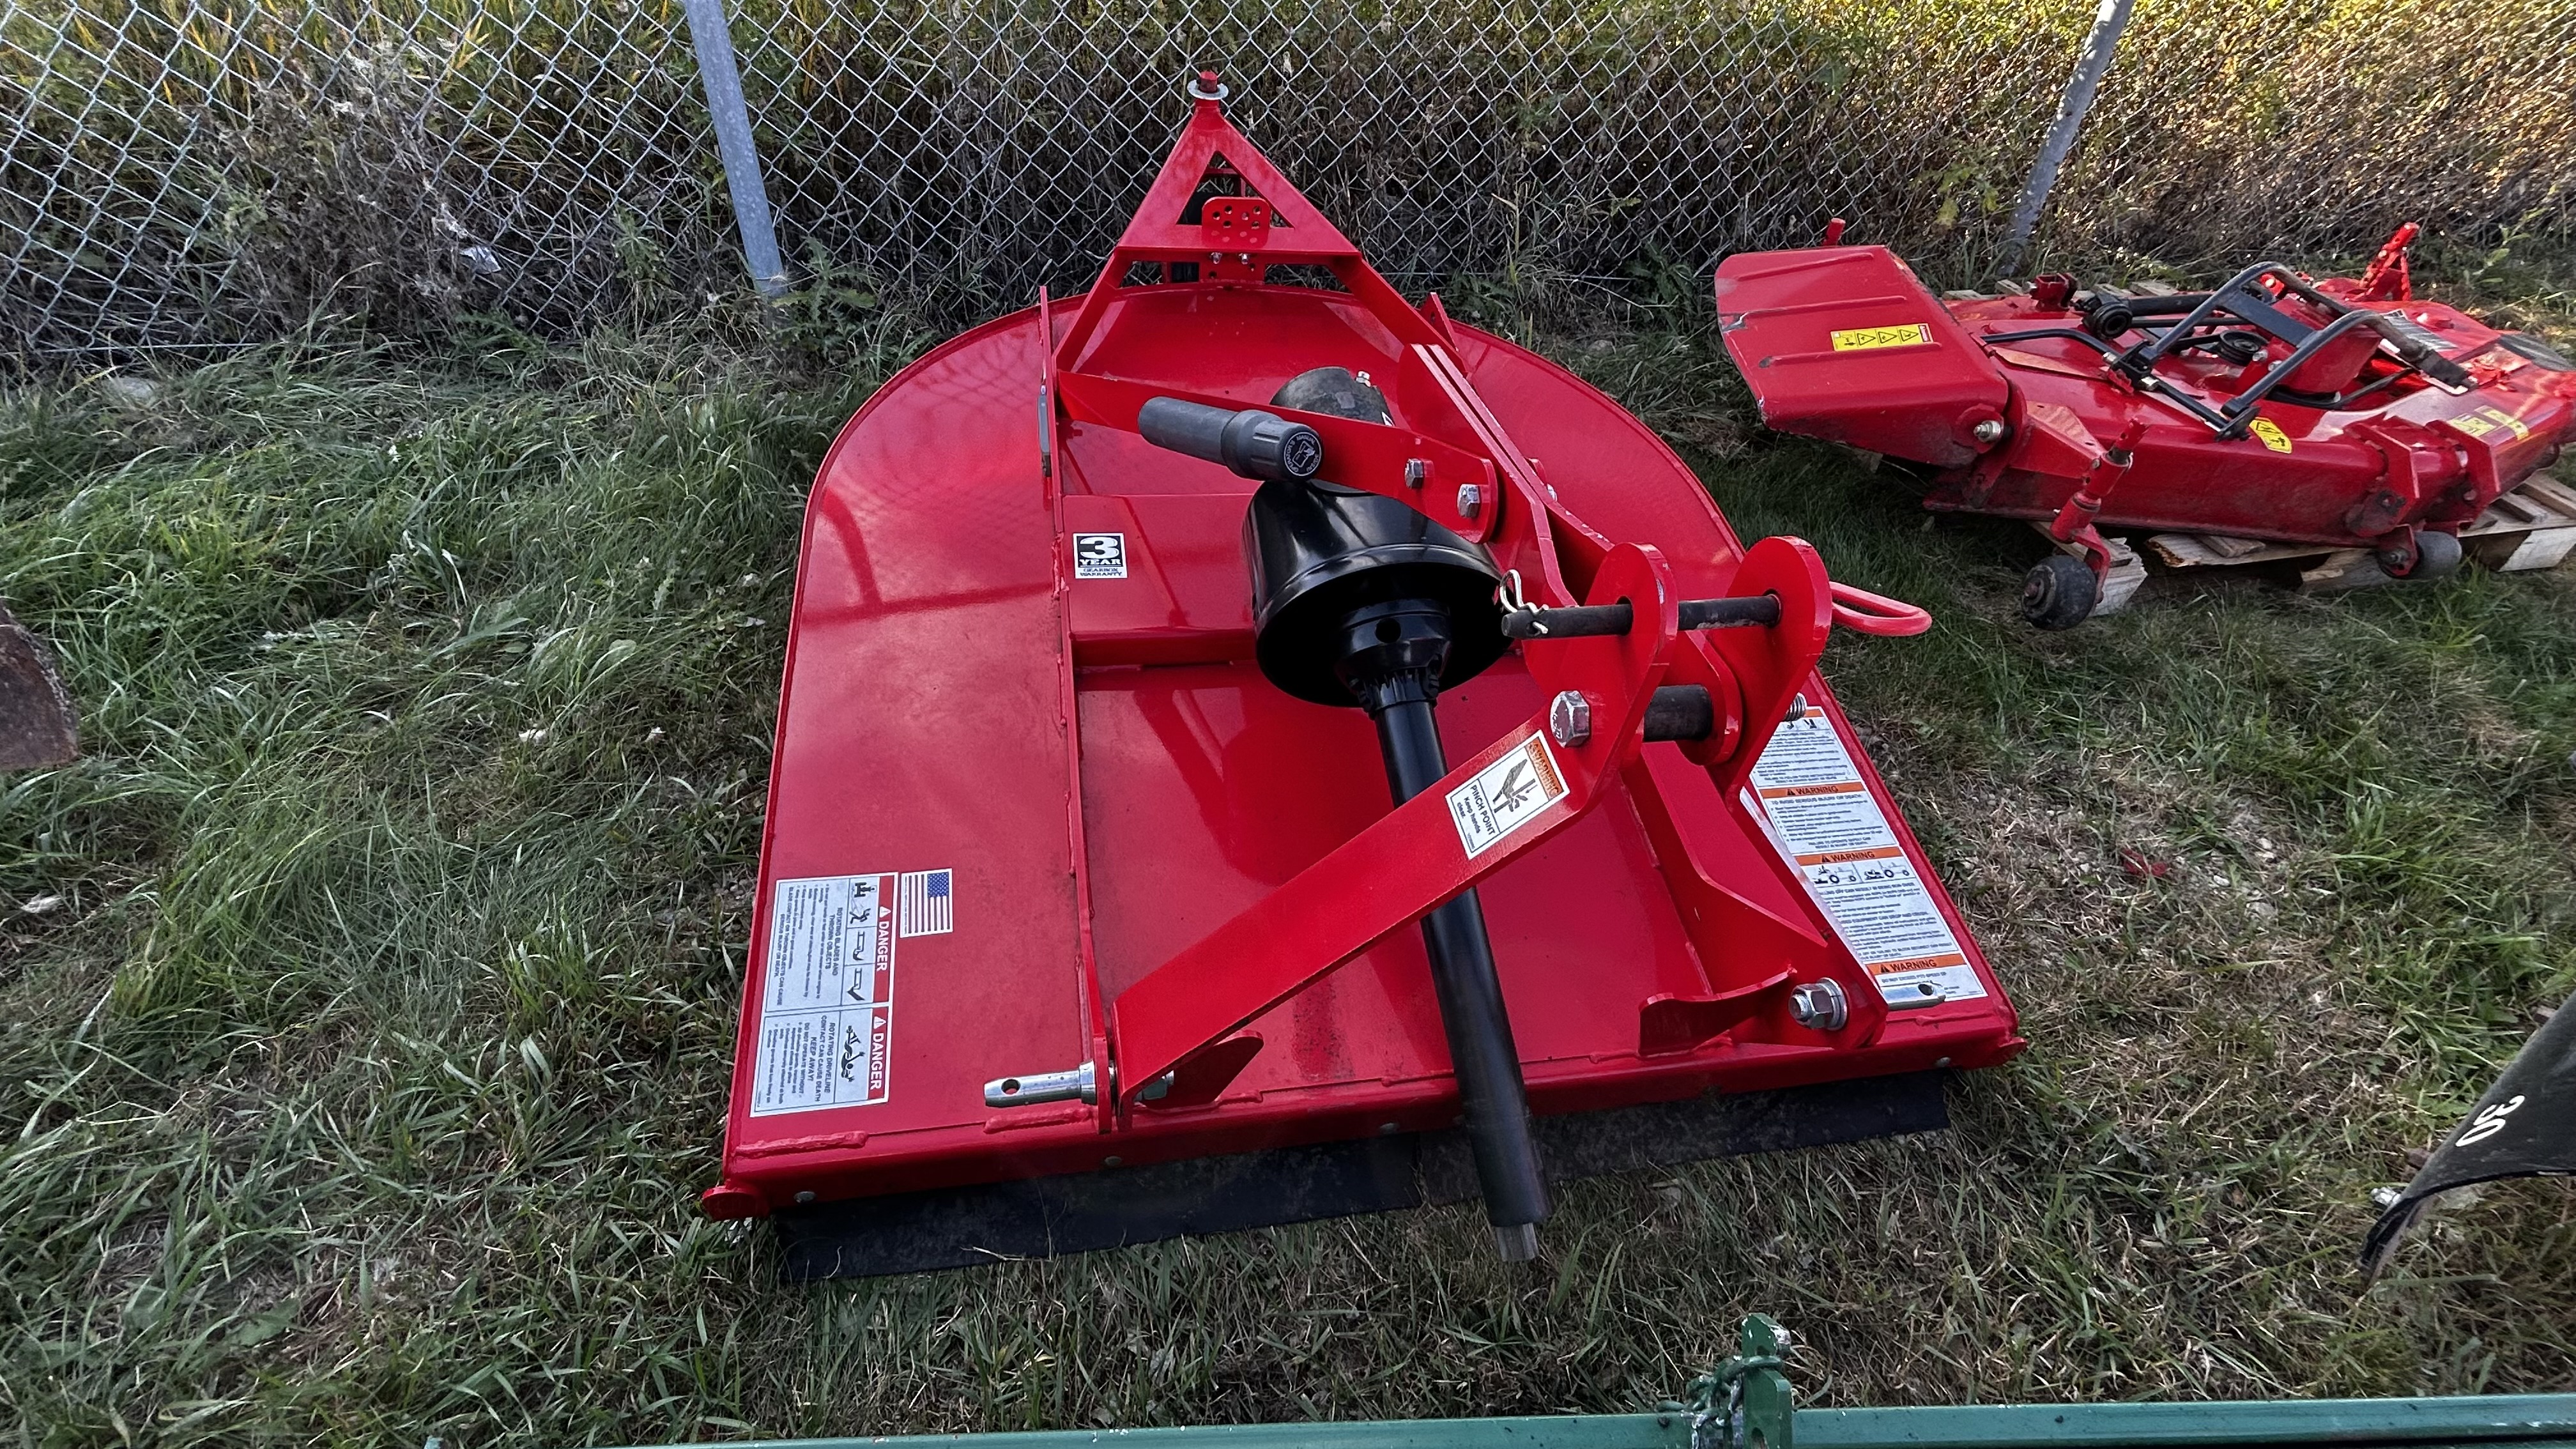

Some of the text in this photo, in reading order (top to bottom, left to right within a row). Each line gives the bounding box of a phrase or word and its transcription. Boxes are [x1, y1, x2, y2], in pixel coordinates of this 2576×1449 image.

[1080, 537, 1119, 559] 3
[1469, 784, 1496, 836] PINCH POINT
[1795, 785, 1839, 794] WARNING
[1462, 796, 1474, 815] Keep
[1469, 812, 1482, 834] hands
[1829, 851, 1876, 861] WARNING
[876, 921, 889, 971] DANGER
[1889, 959, 1938, 971] WARNING
[804, 1022, 809, 1031] DO
[807, 1036, 817, 1082] KEEP AWAY!
[824, 1022, 835, 1093] ROTATING DRIVELINE
[870, 1032, 884, 1089] DANGER
[2455, 1095, 2525, 1147] 30
